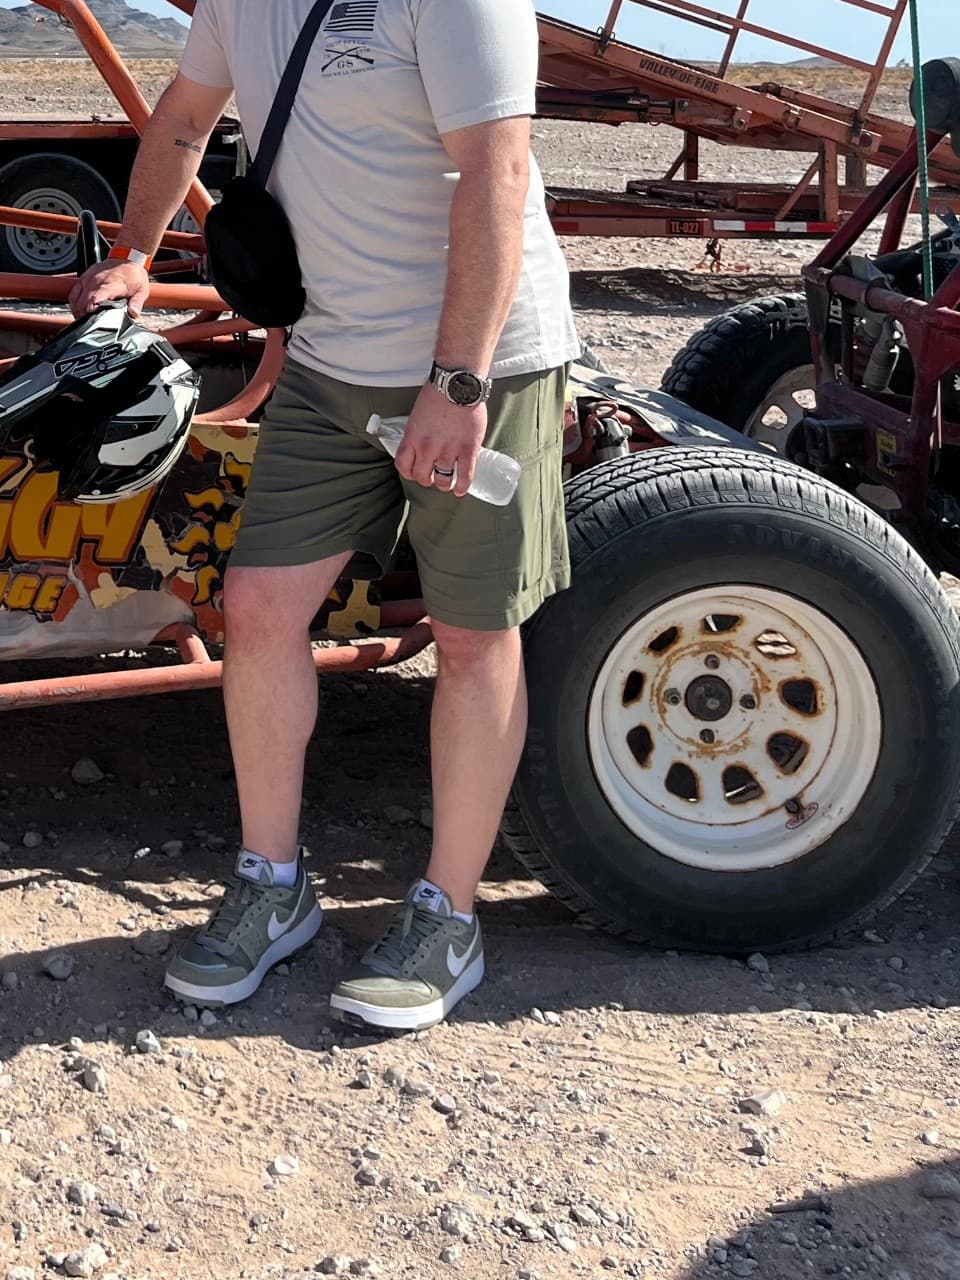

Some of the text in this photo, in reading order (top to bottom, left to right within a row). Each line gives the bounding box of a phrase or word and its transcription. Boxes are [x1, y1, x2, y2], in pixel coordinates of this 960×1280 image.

[337, 59, 353, 69] GS
[640, 59, 720, 94] VALLEY OF FIRE
